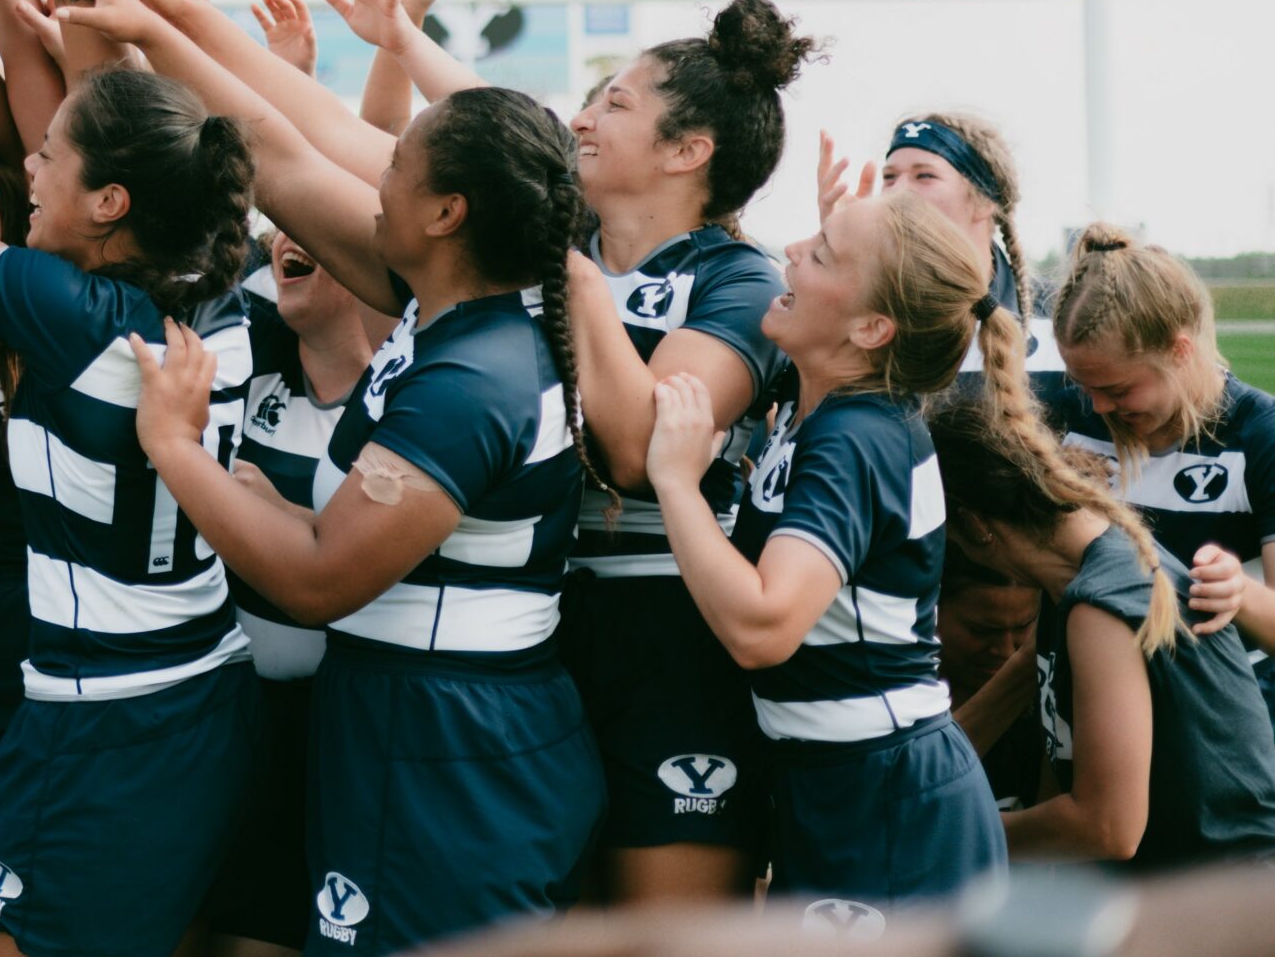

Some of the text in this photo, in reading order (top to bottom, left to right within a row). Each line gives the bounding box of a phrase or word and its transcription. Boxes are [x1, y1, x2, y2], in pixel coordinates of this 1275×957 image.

[901, 123, 931, 138] Y
[1183, 465, 1225, 501] Y
[671, 756, 725, 794] Y
[327, 876, 358, 920] Y
[319, 918, 357, 946] RUGBY
